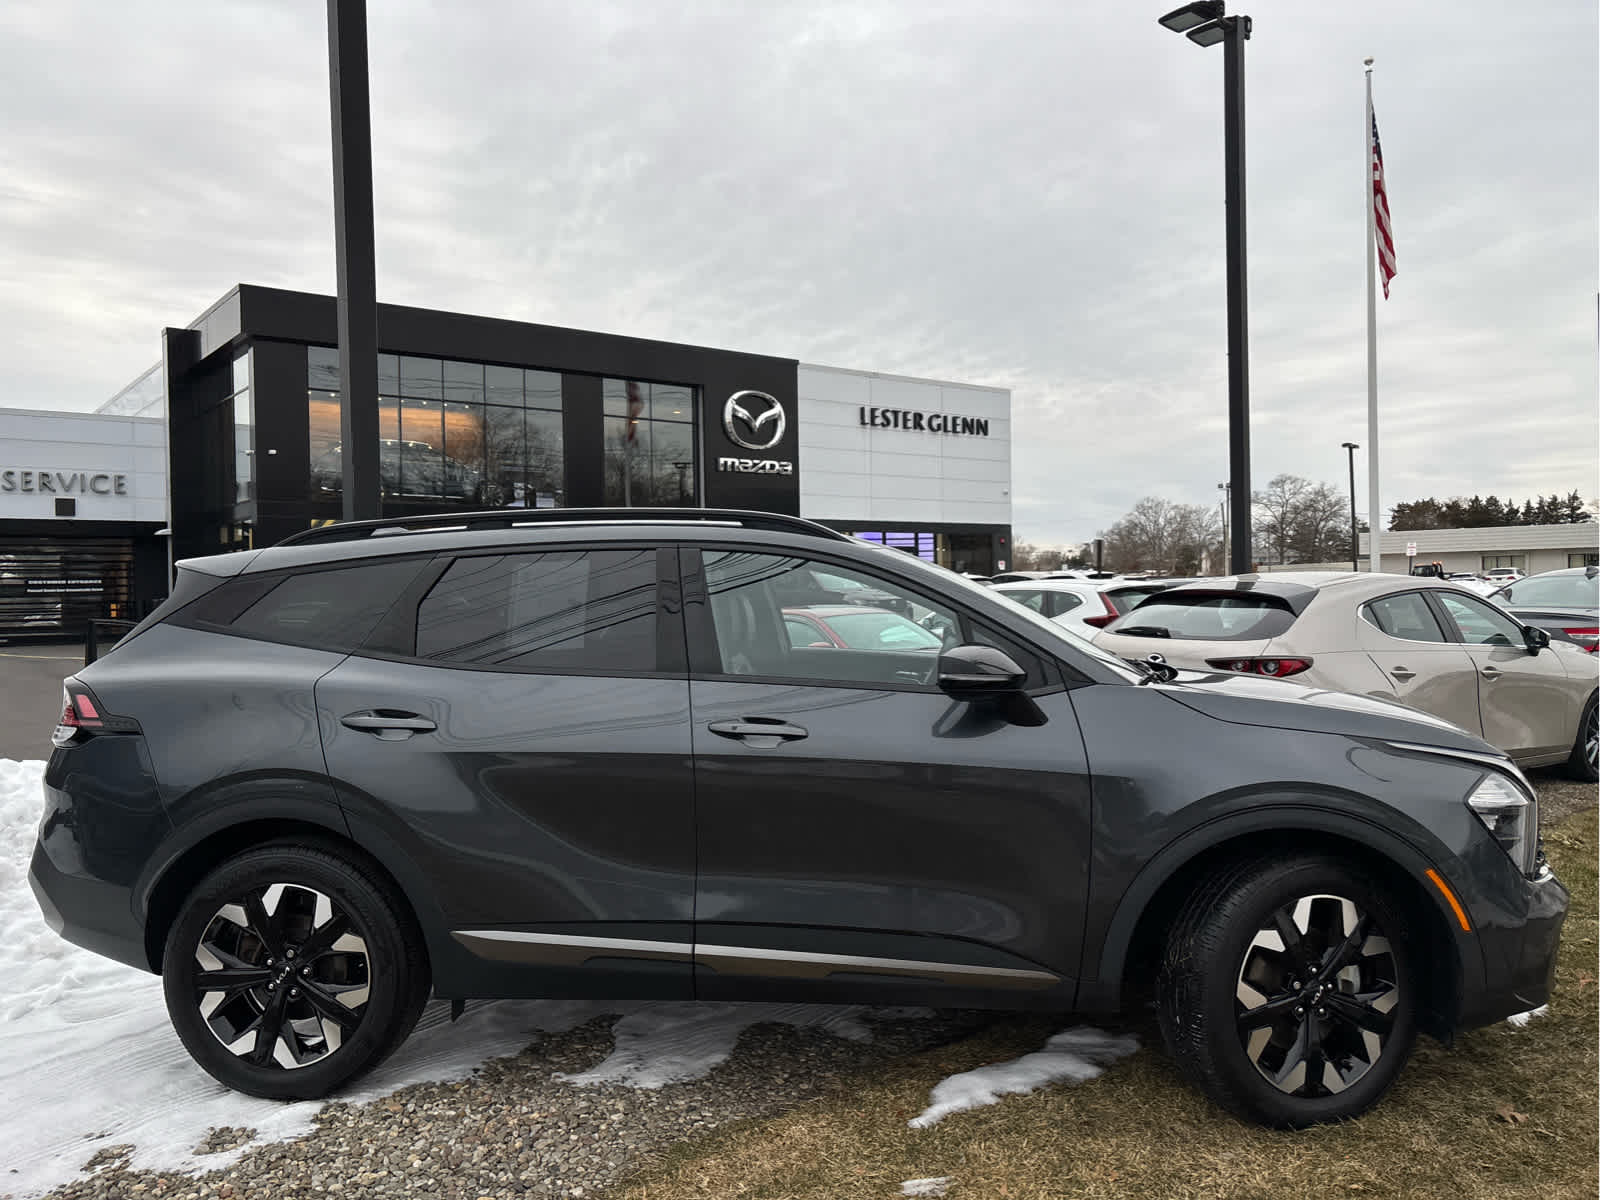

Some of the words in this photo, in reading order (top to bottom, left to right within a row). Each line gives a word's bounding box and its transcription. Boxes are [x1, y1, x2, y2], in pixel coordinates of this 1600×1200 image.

[860, 406, 924, 431] LESTER
[927, 414, 989, 436] GLENN
[1, 470, 127, 495] SERVICE
